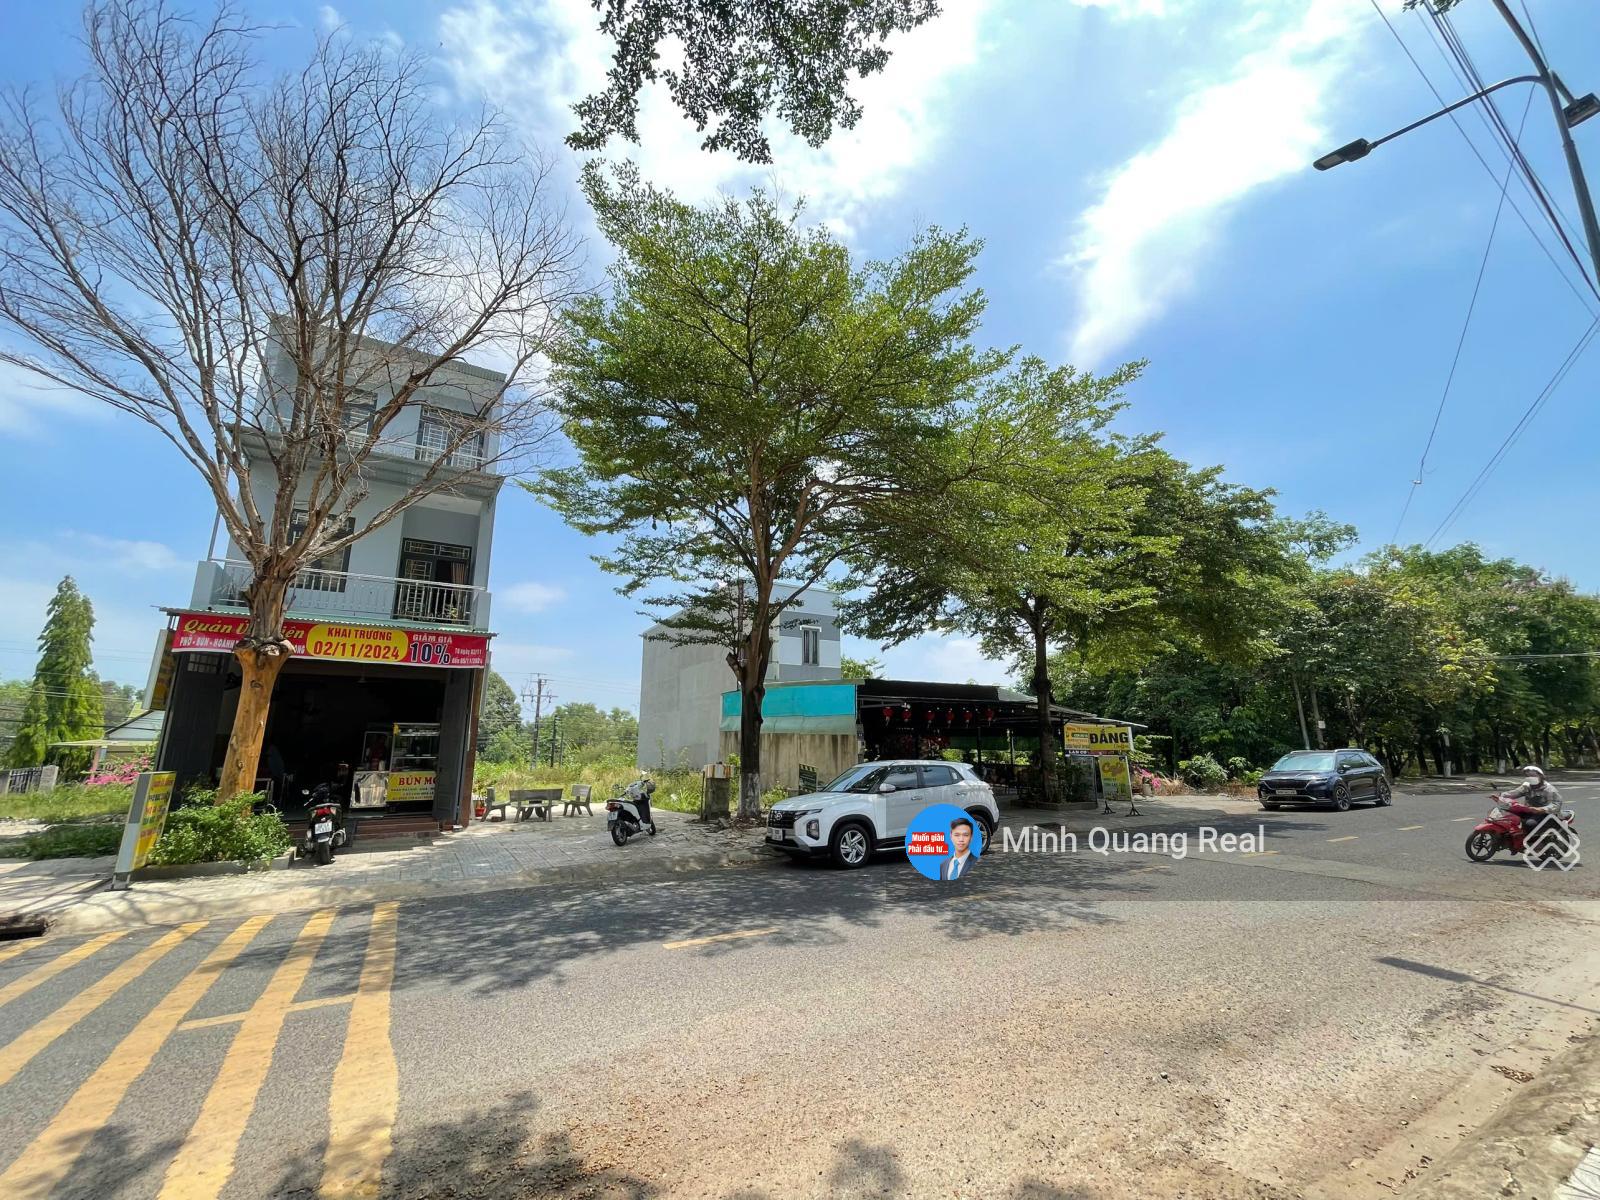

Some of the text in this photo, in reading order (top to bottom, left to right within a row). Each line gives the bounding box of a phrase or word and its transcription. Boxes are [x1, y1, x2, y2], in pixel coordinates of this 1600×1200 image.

[184, 620, 232, 634] Quán
[327, 627, 352, 638] KHAI
[313, 640, 400, 660] 02/11/2024
[409, 641, 451, 665] 10%
[399, 775, 421, 785] BÚN
